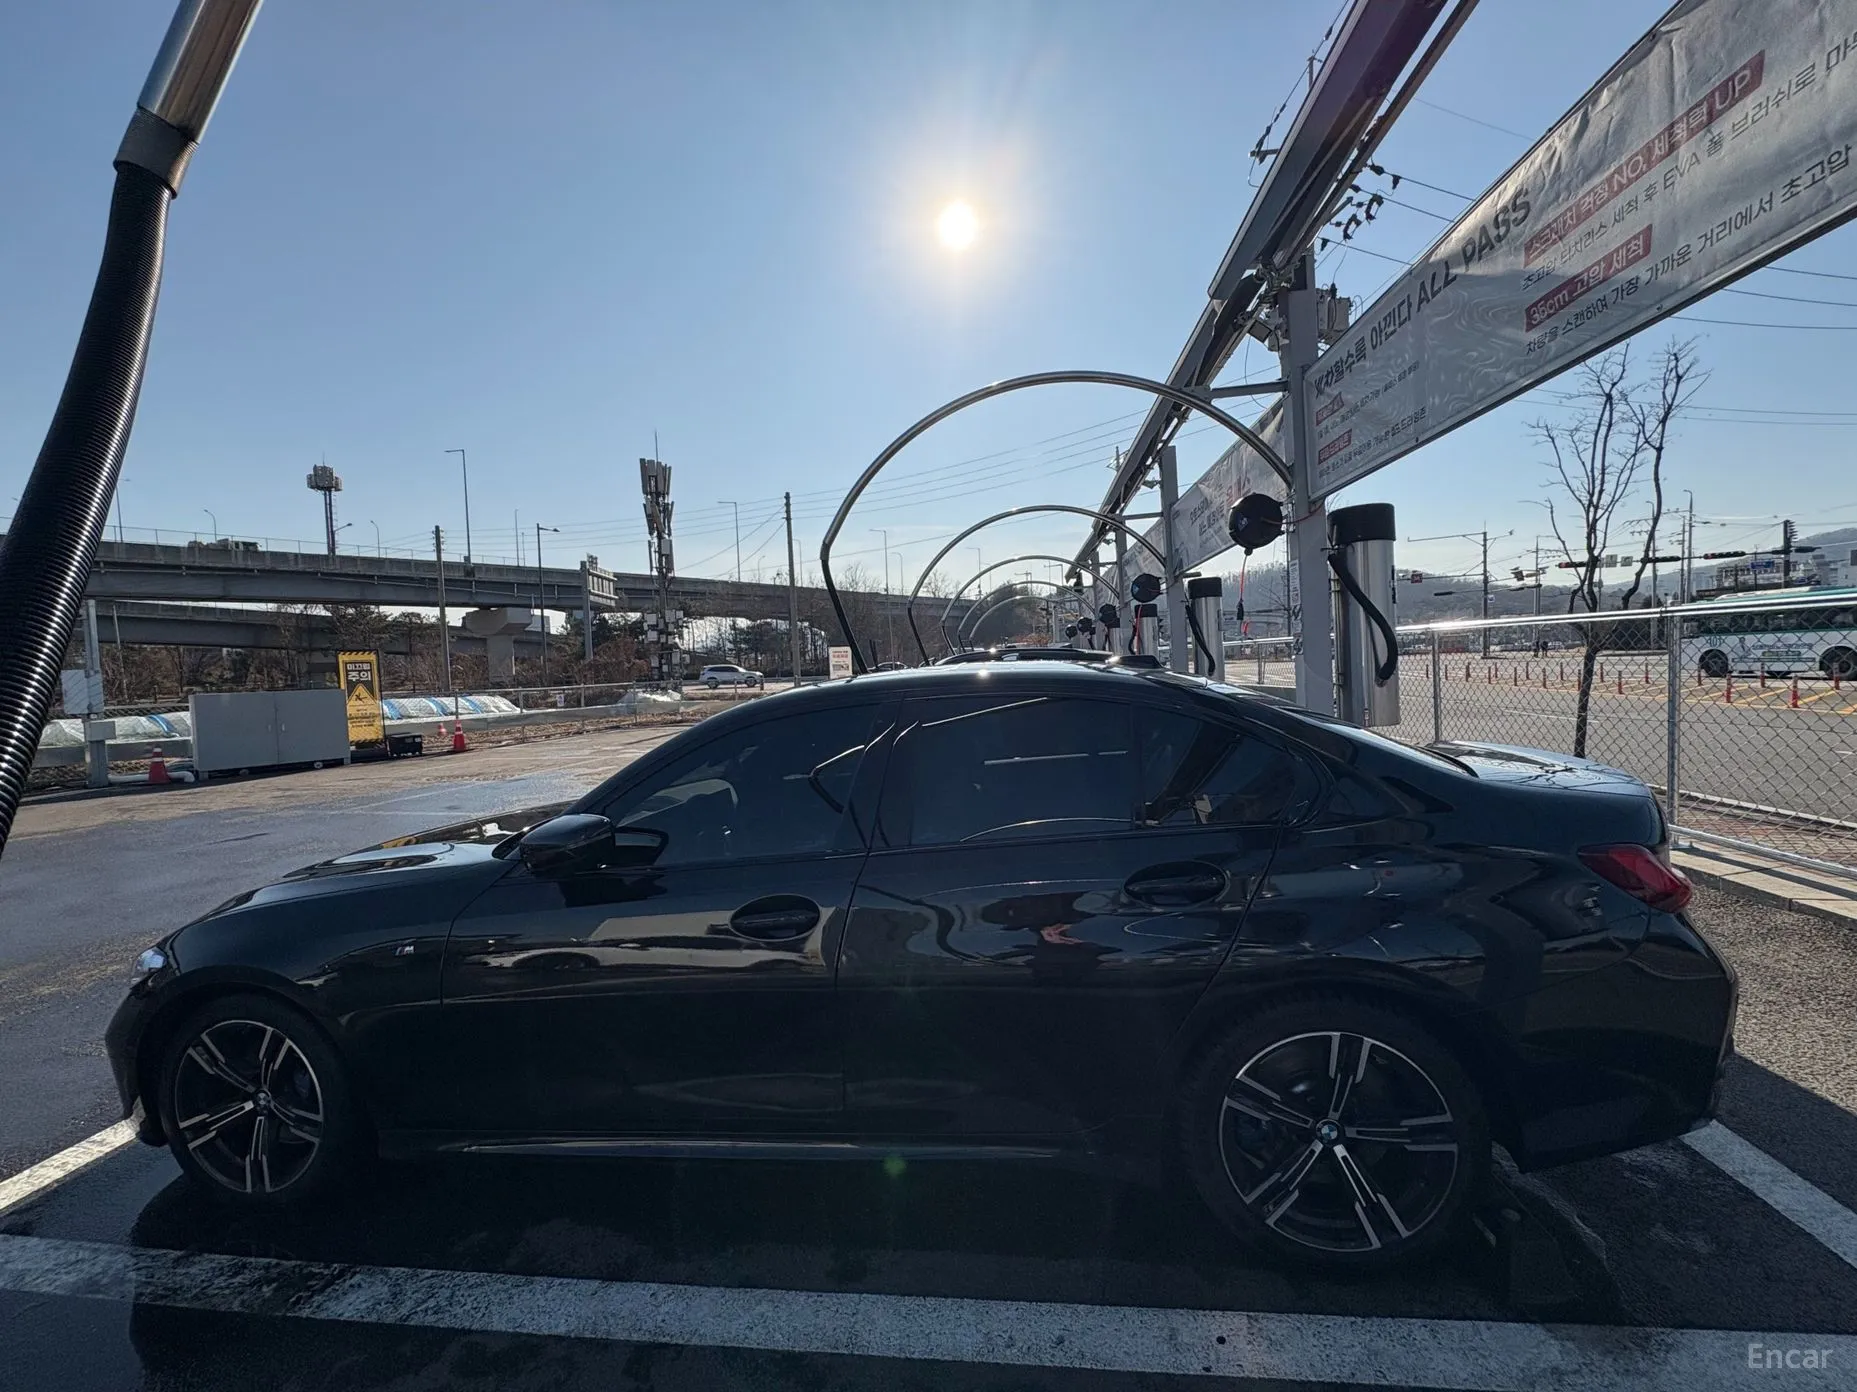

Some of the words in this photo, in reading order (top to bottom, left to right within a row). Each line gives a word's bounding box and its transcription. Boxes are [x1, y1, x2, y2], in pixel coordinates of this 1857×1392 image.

[1526, 325, 1559, 355] 차량을
[1561, 295, 1608, 336] 스캔하여
[1611, 275, 1640, 304] 가장
[1645, 243, 1691, 286] 가까운
[1698, 191, 1774, 253] 거리에서
[1781, 144, 1852, 204] 초고압
[1529, 206, 1576, 259] 스크래치
[1581, 184, 1609, 212] 걱정
[1715, 69, 1750, 108] UP
[1561, 220, 1608, 265] 터치리스
[1612, 195, 1639, 227] 세척
[1643, 181, 1659, 203] 후
[1663, 151, 1701, 191] EVA
[1731, 62, 1816, 141] 브러쉬로
[1370, 293, 1413, 350] 아낀다
[1416, 260, 1457, 313] ALL
[1461, 187, 1532, 272] PASS
[1530, 290, 1569, 324] 35cm
[1572, 260, 1604, 296] 고압
[1609, 234, 1644, 273] 세척
[347, 671, 371, 682] 주의
